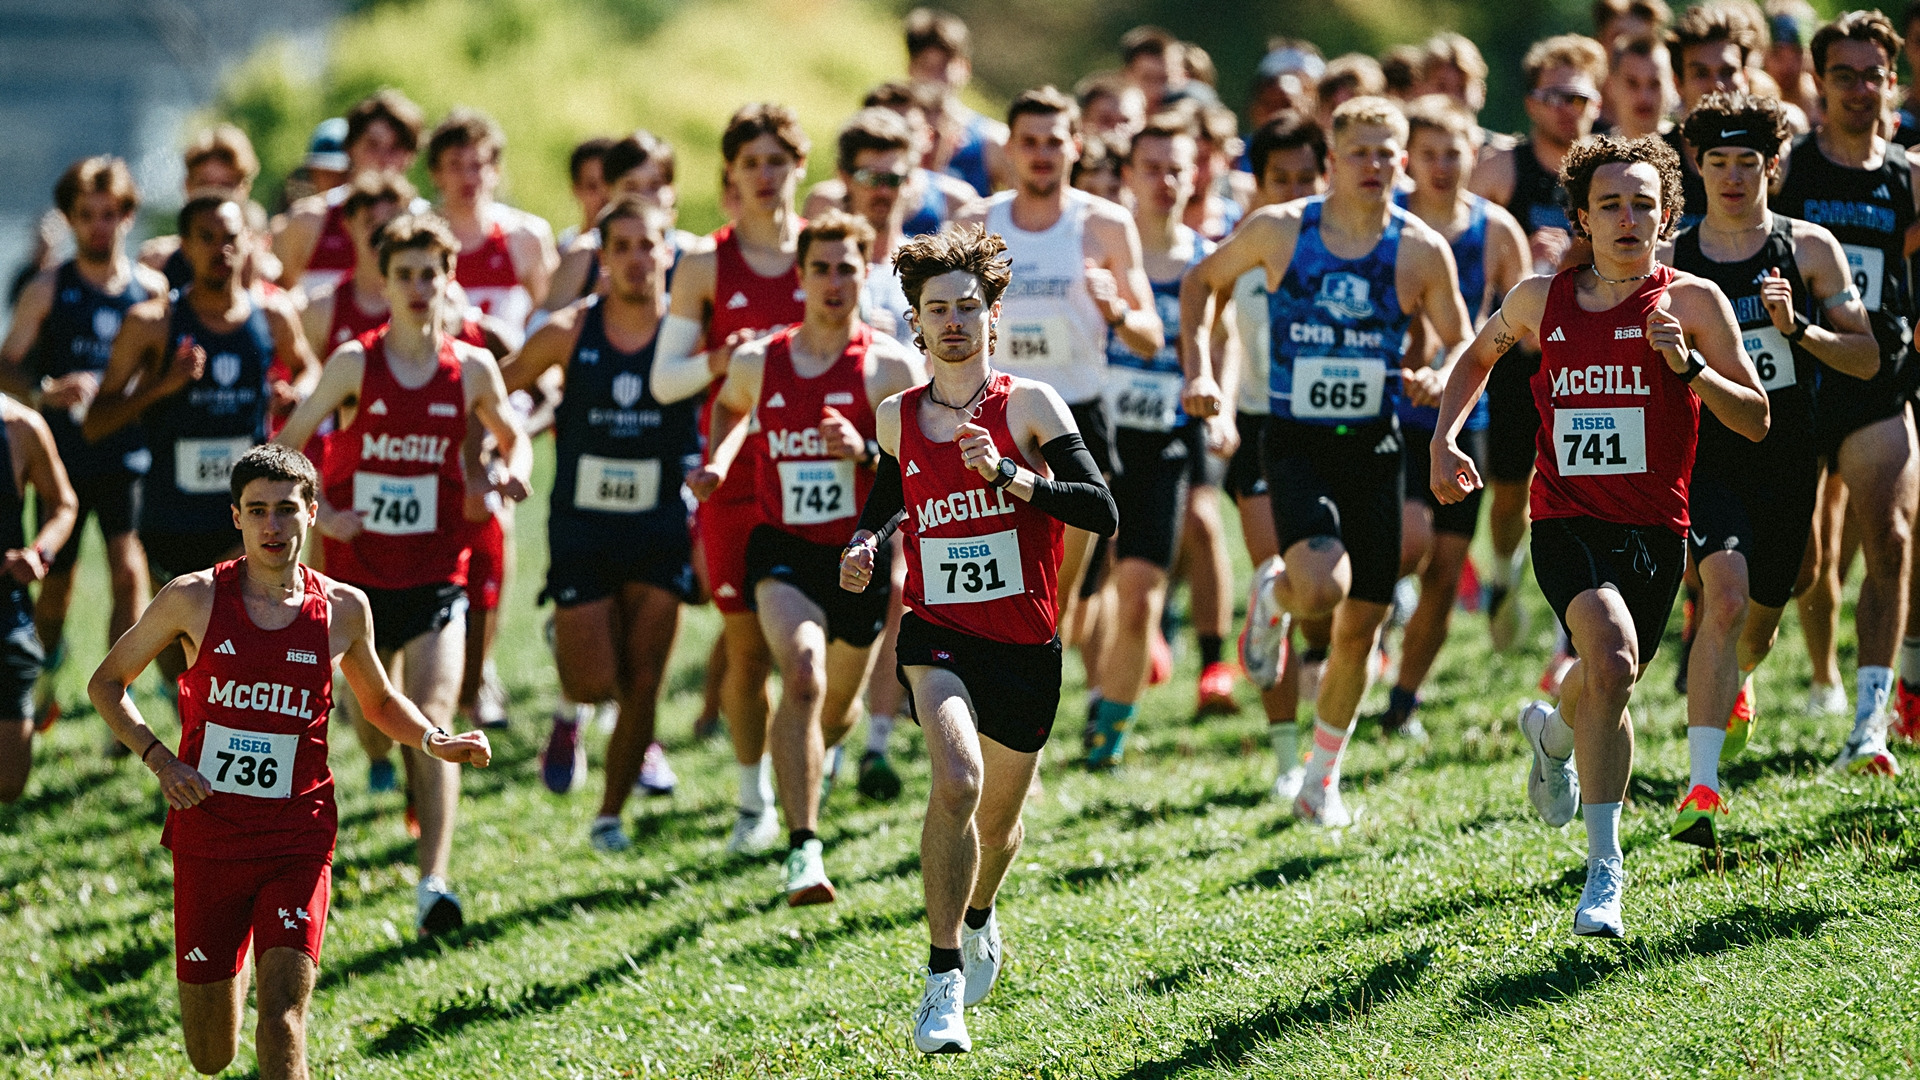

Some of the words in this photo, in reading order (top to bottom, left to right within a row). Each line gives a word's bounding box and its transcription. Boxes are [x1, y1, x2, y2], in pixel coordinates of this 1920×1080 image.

[1614, 328, 1643, 340] RSEQ
[1310, 382, 1367, 408] 665
[1572, 417, 1616, 430] RSEQ
[1563, 433, 1627, 466] 741
[372, 497, 420, 525] 740
[791, 485, 842, 512] 742
[916, 486, 1015, 533] McGILL
[947, 544, 991, 559] RSEQ
[940, 558, 1006, 593] 731
[286, 652, 317, 664] RSEQ
[208, 676, 312, 720] McGILL
[228, 737, 272, 754] RSEQ
[216, 751, 278, 789] 736
